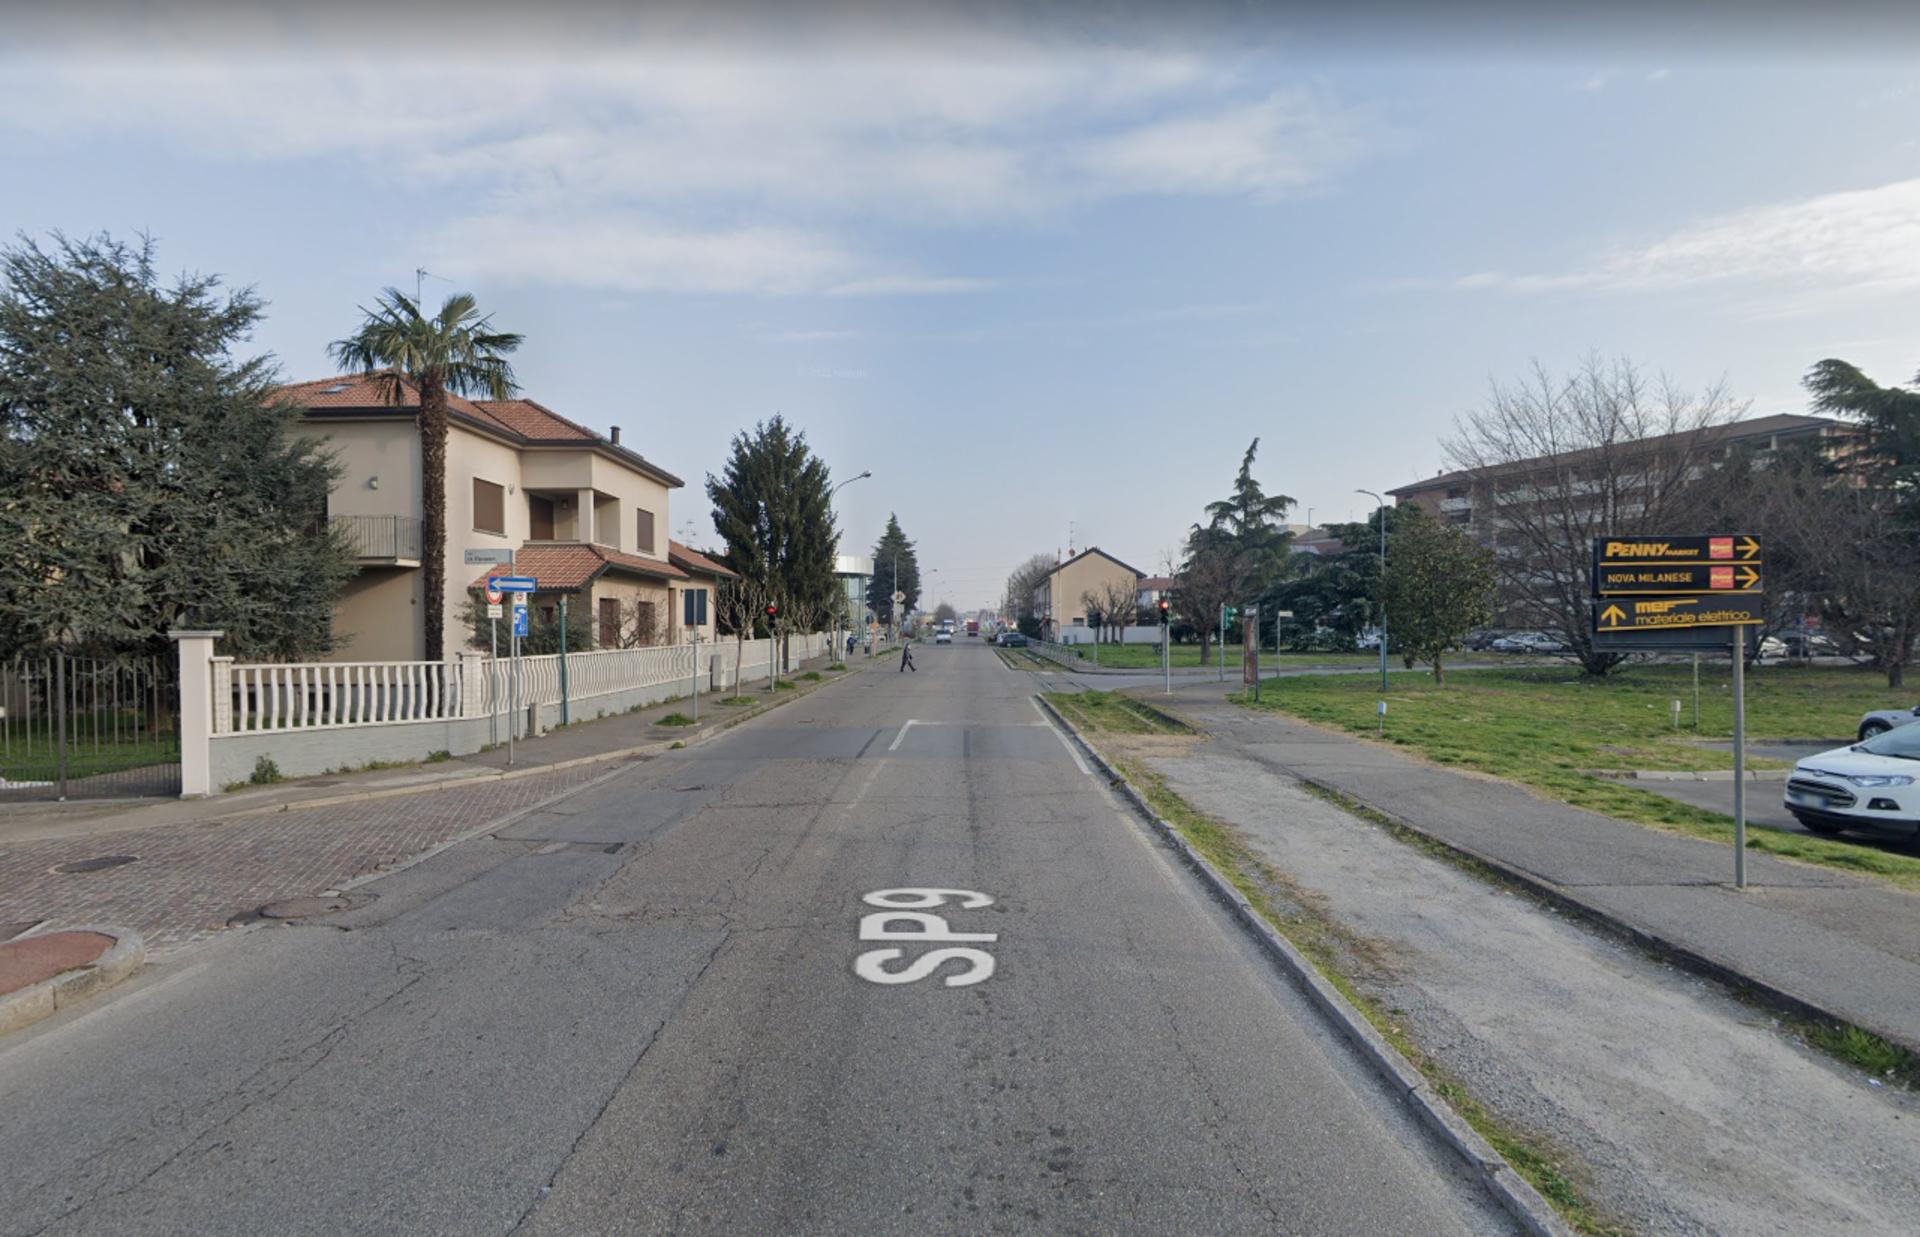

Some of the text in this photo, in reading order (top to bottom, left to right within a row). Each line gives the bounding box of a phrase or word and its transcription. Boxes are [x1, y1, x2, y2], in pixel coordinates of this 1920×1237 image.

[1606, 542, 1669, 556] PENNY
[1608, 574, 1692, 583] NOVA MILANESE
[1636, 611, 1750, 624] materiale elettrico
[854, 887, 998, 987] SP9
